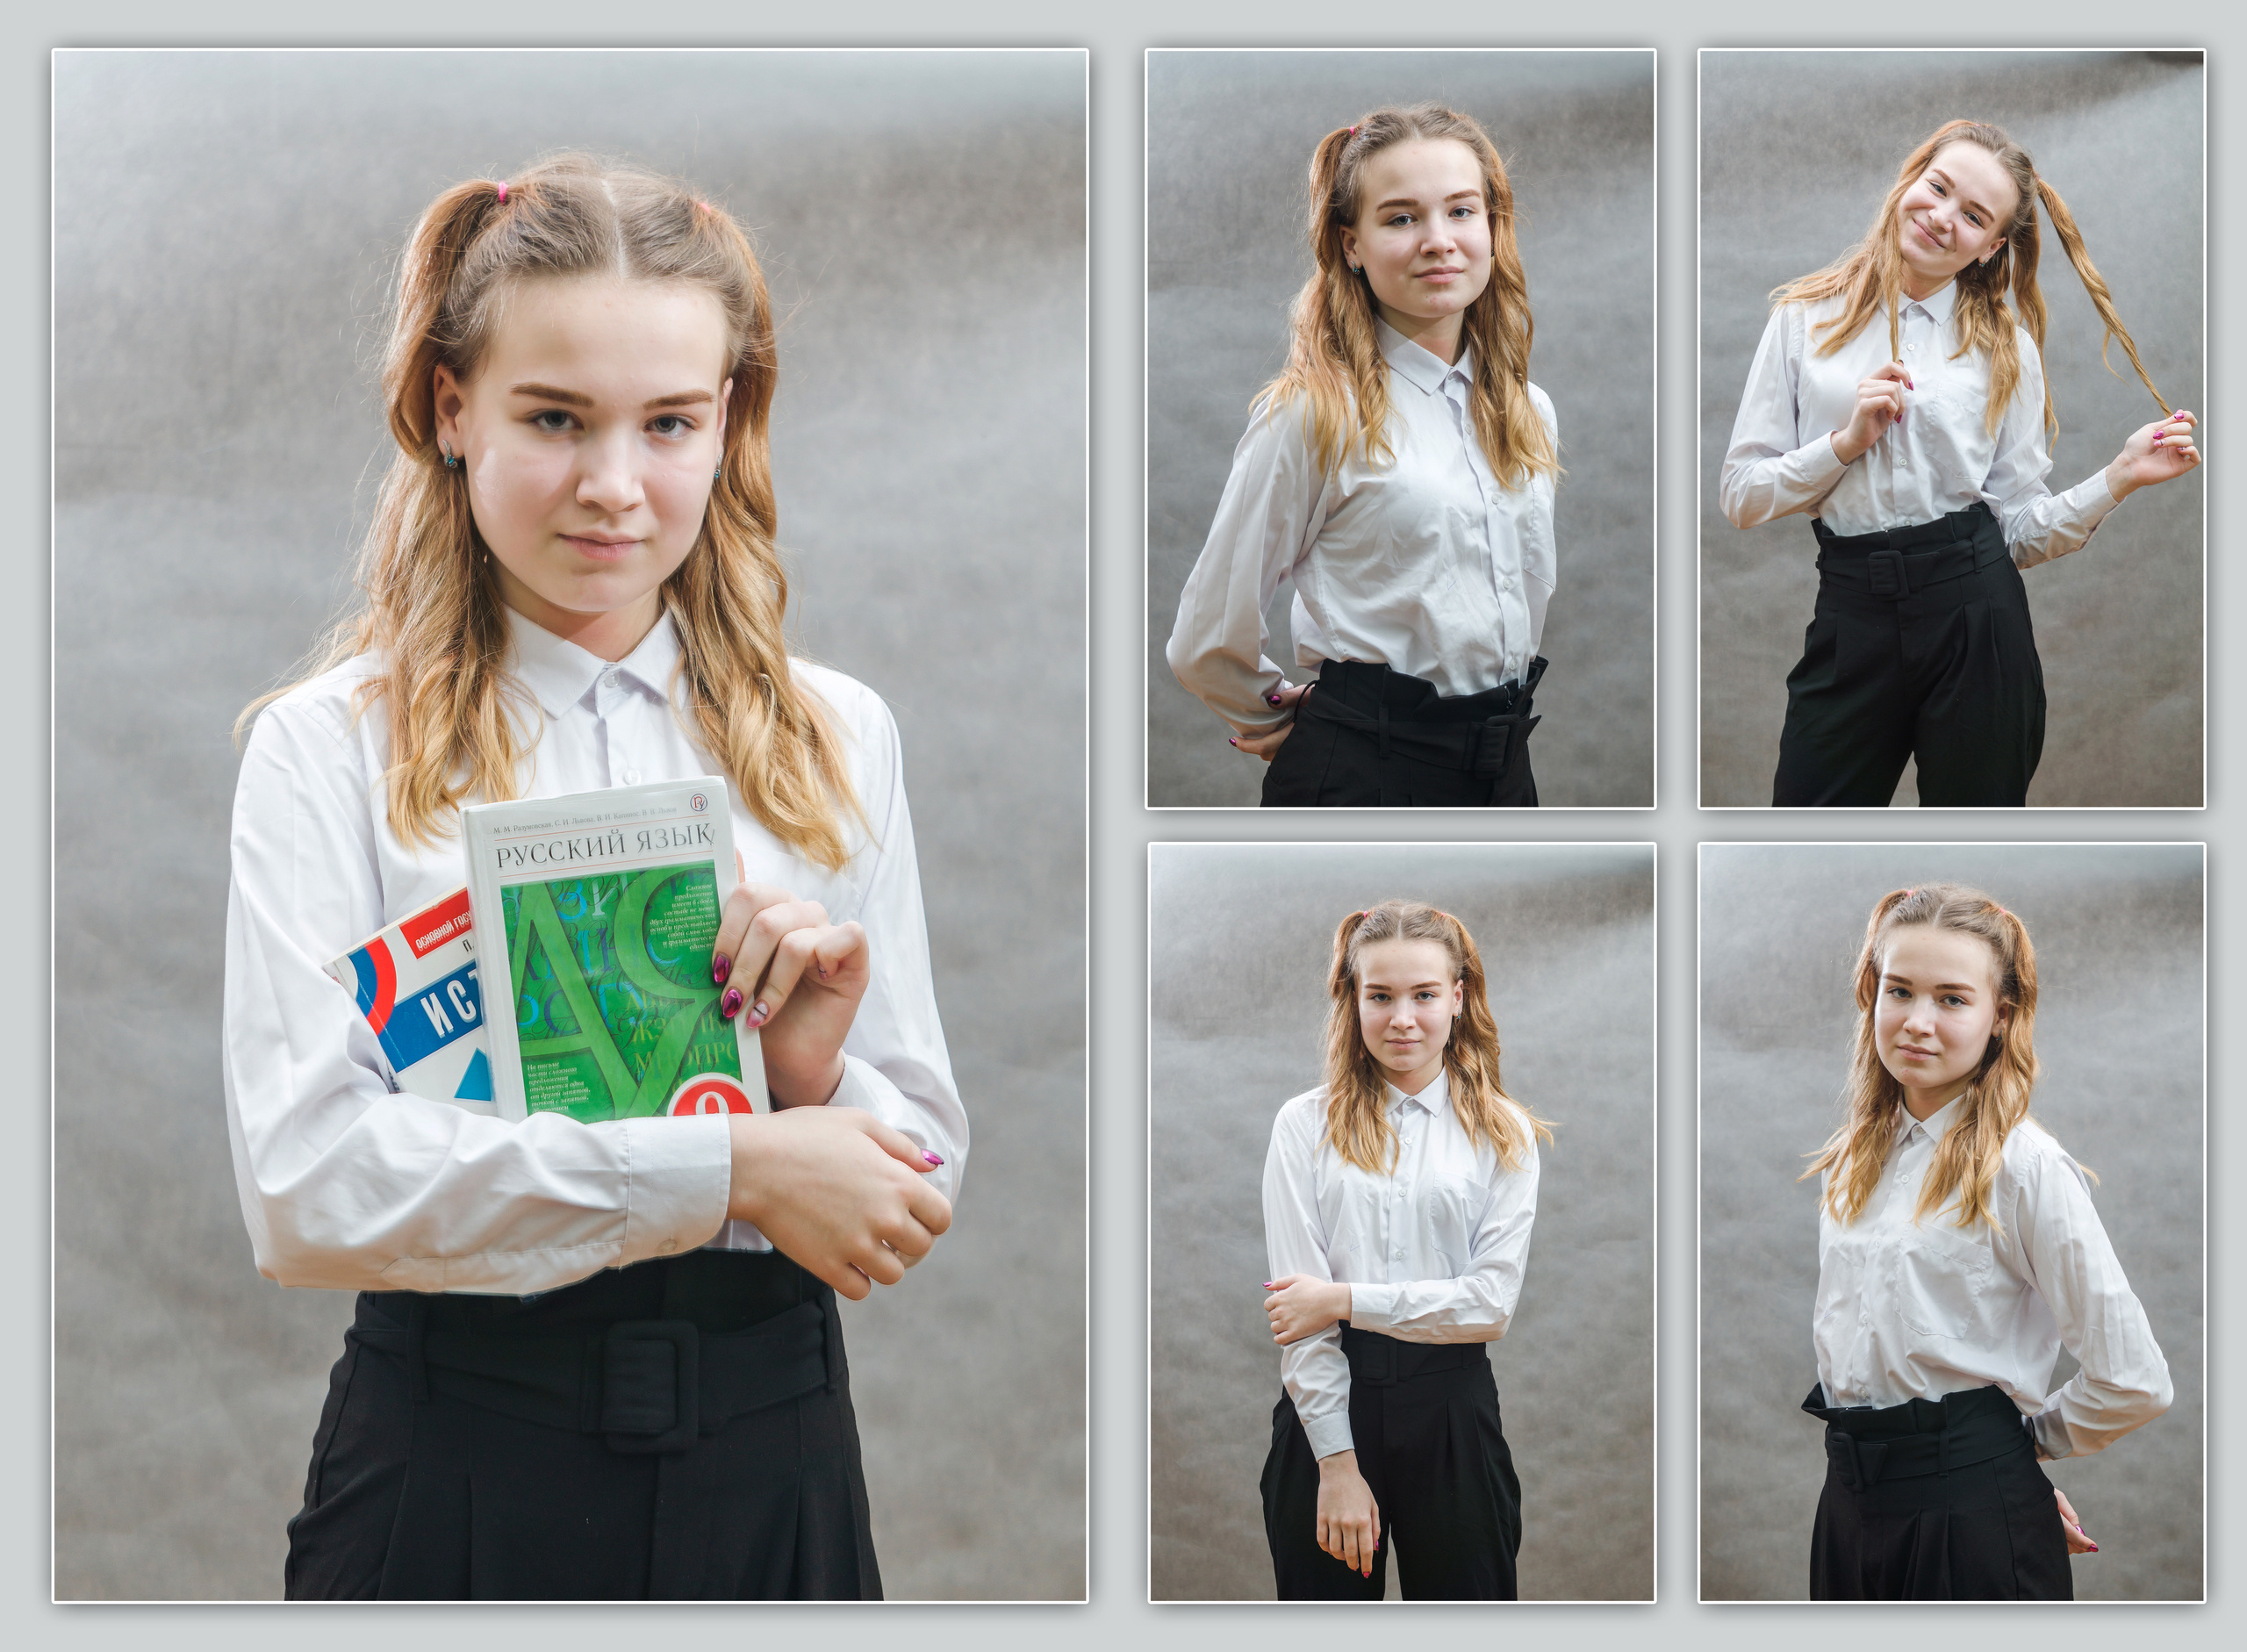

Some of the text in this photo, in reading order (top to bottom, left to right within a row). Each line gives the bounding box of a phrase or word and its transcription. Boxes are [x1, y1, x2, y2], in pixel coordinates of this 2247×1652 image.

[495, 822, 715, 869] РУССКИЙ ЯЗЫК
[674, 891, 714, 901] предложение
[664, 908, 689, 916] составе
[664, 913, 716, 924] грамматических
[415, 919, 455, 949] ОСНОВНОЙ
[668, 935, 716, 946] грамматическо
[528, 1076, 569, 1086] предложения
